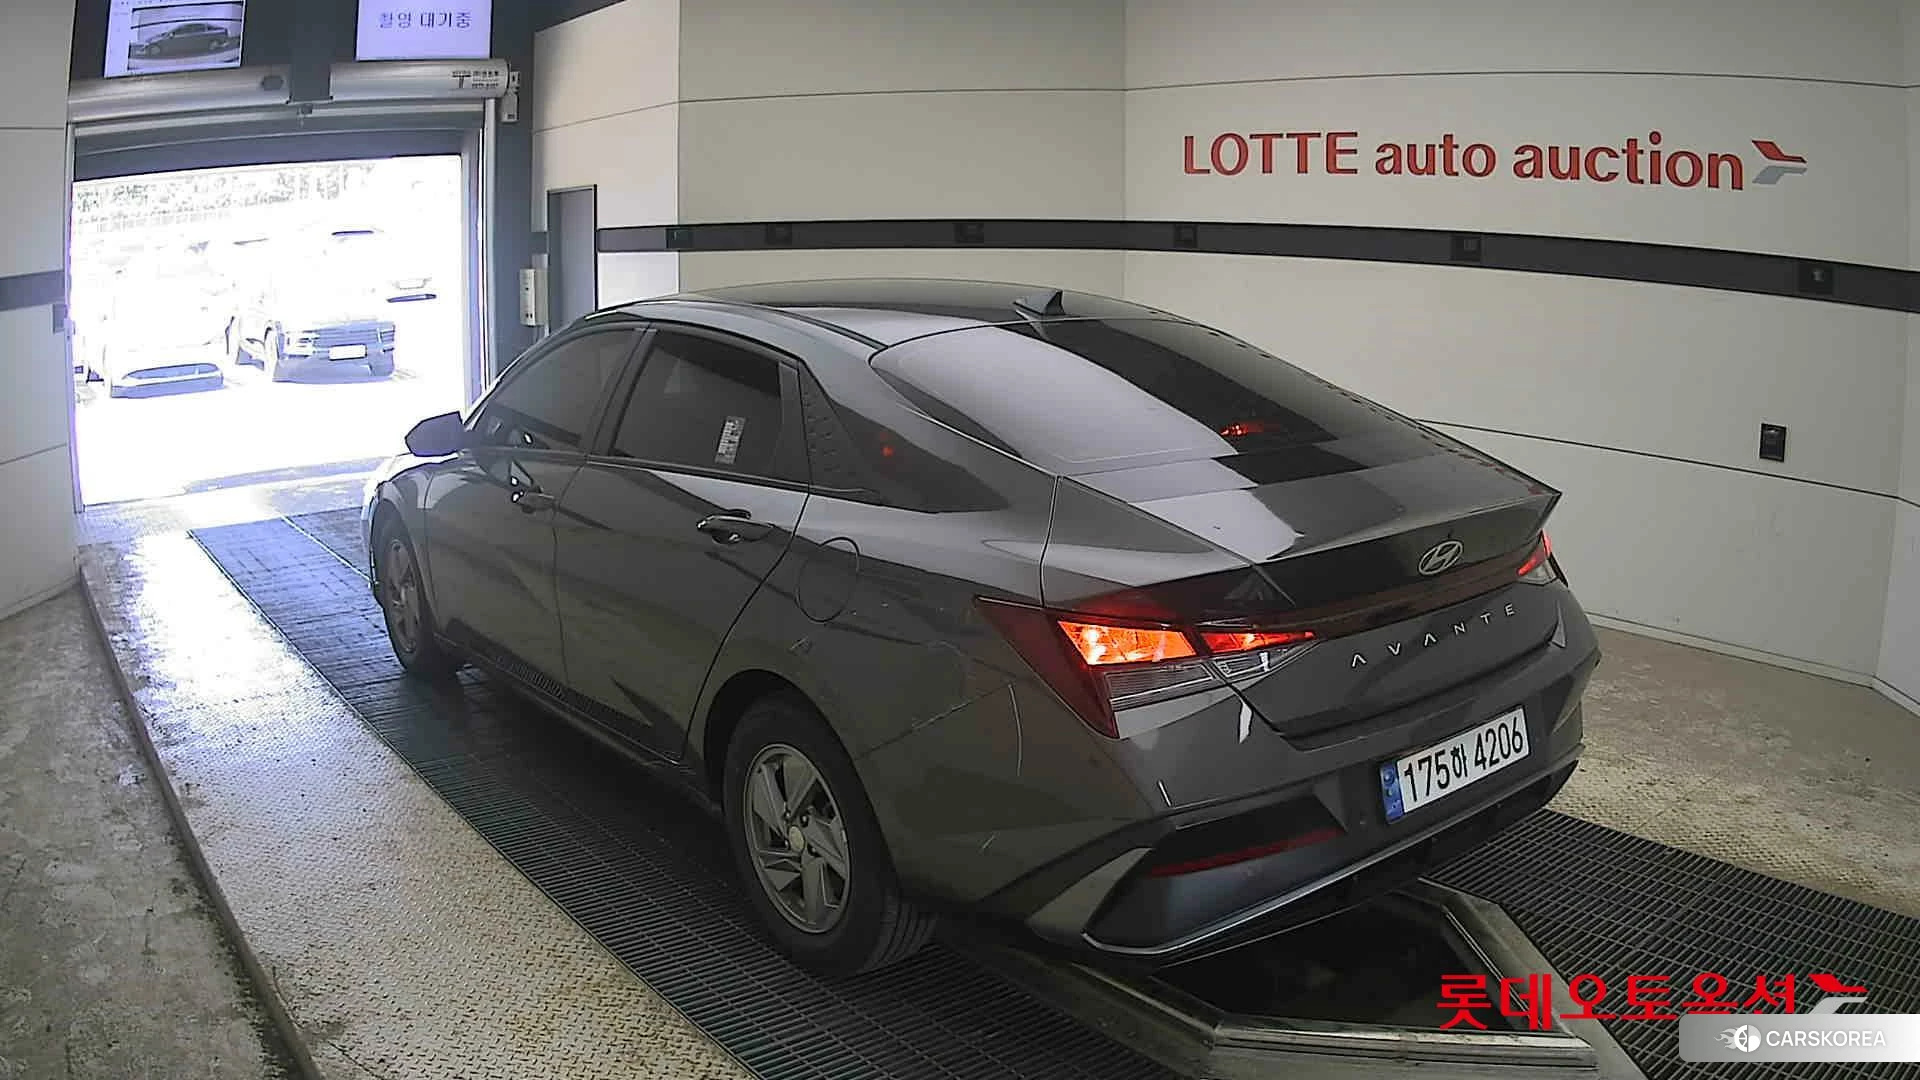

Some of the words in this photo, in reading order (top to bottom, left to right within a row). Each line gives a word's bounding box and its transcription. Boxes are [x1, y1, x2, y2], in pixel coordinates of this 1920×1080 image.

[421, 12, 472, 28] 대기중
[1183, 131, 1359, 176] LOTTE
[1374, 133, 1497, 178] auto
[1513, 130, 1745, 192] auction
[1351, 603, 1515, 668] AVANTE
[1404, 743, 1468, 803] 175하
[1474, 716, 1524, 770] 4206
